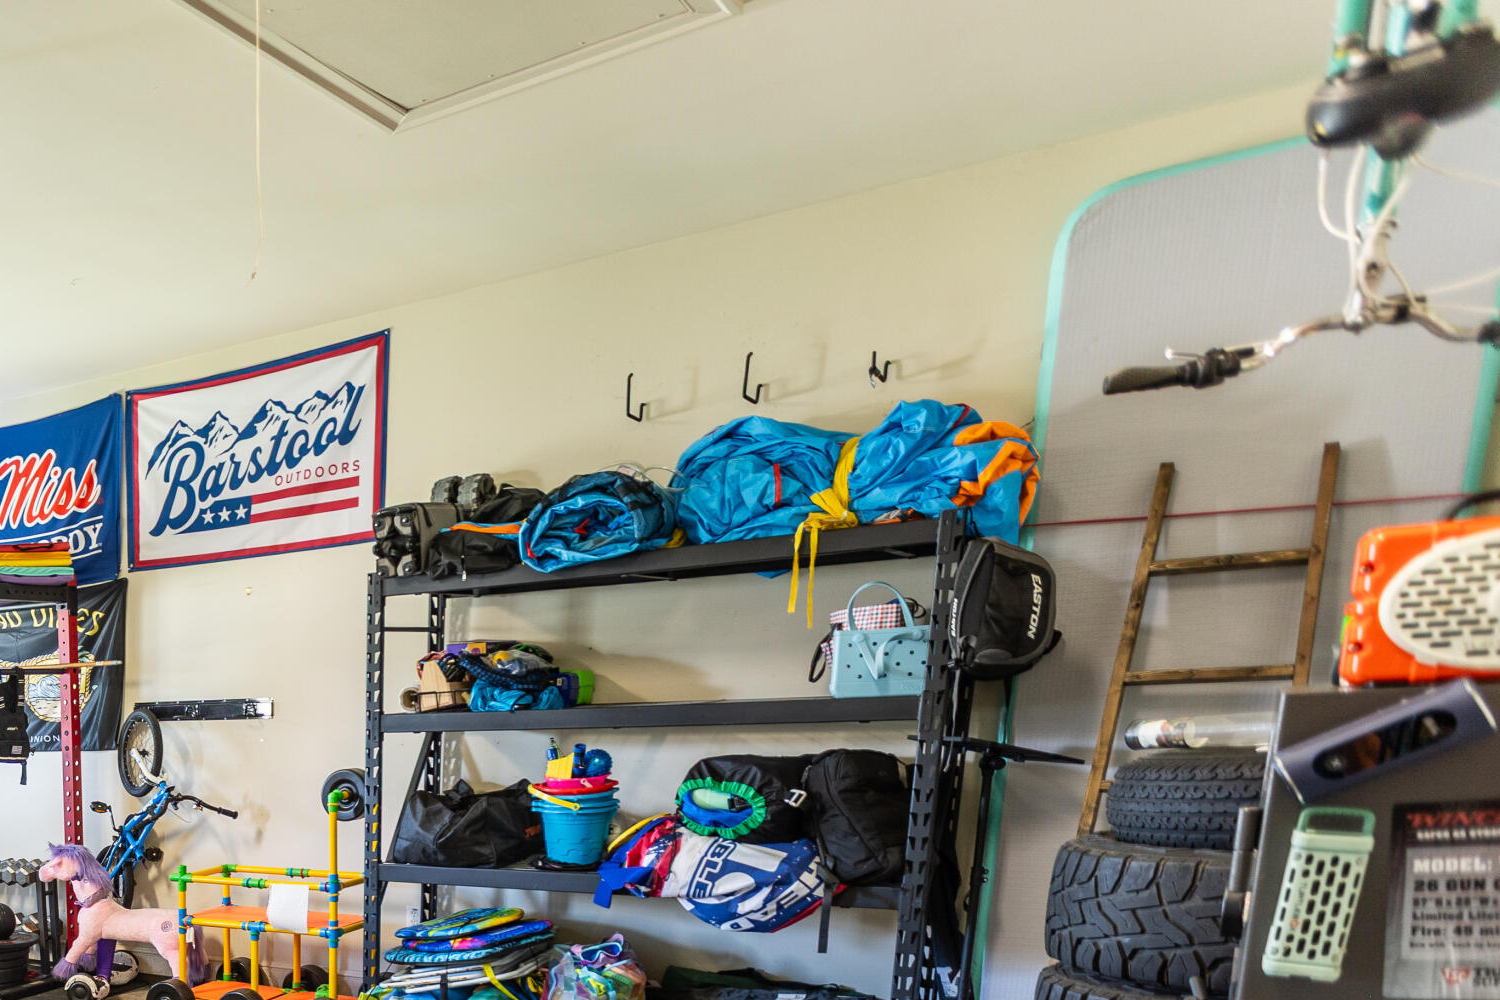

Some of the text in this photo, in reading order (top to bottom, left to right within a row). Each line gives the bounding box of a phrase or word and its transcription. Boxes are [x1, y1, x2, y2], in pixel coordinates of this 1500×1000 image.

[148, 383, 367, 537] Barstool
[274, 459, 361, 487] OUTDOORS
[1026, 573, 1043, 640] EASTON
[30, 607, 106, 637] VIES
[1413, 856, 1493, 875] MODEL:
